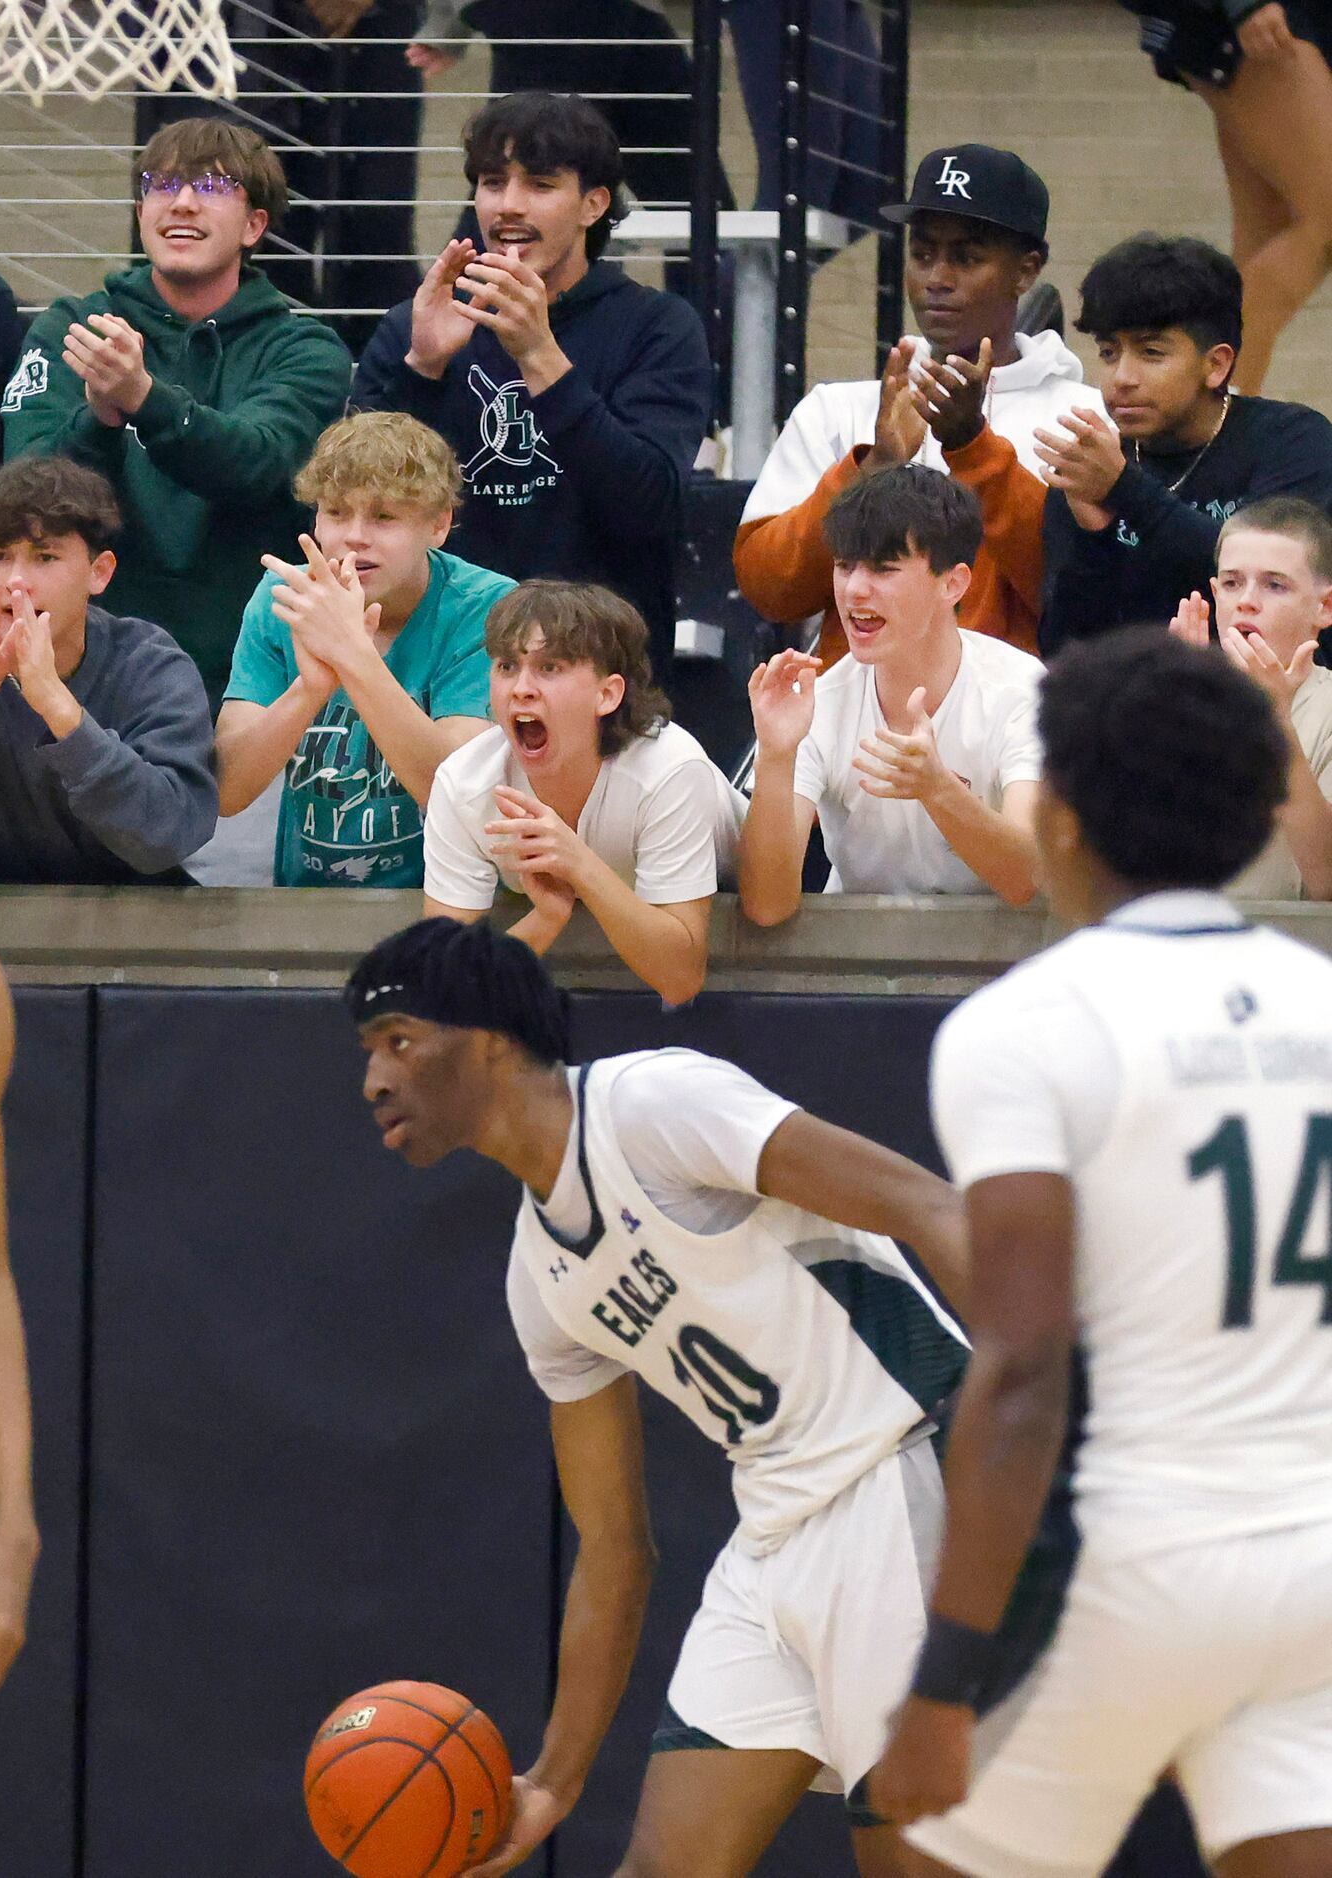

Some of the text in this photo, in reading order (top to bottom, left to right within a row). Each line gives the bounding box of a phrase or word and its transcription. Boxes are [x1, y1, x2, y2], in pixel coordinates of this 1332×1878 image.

[935, 156, 972, 200] LR
[473, 484, 515, 495] LAKE
[379, 854, 405, 872] 23
[1184, 1112, 1332, 1331] 14
[666, 1323, 781, 1445] 10
